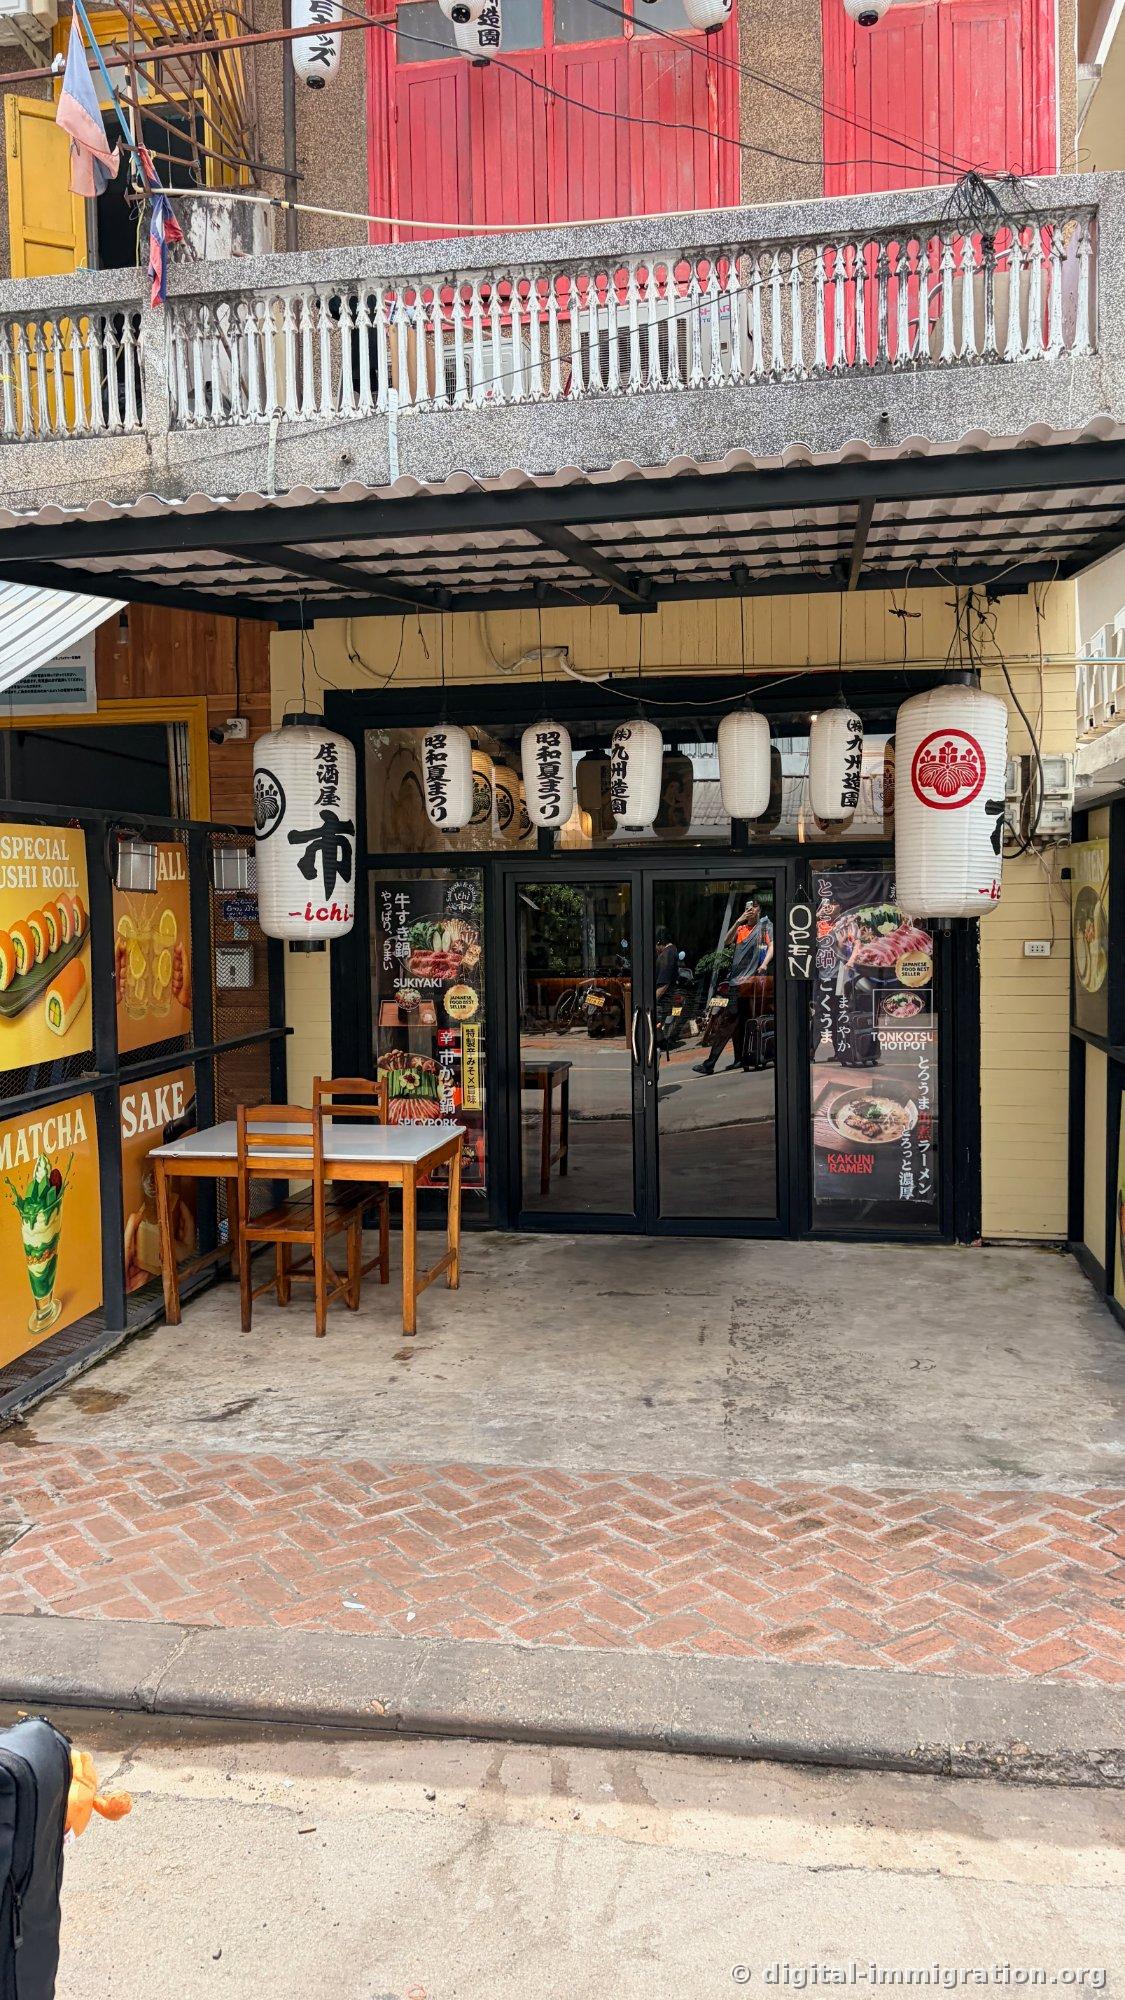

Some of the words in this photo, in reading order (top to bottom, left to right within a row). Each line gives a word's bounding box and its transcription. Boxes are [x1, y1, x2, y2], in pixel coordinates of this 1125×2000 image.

[313, 742, 341, 807] 居酒屋
[424, 733, 451, 823] 昭和夏まつり
[535, 730, 564, 820] 昭和夏まつり
[0, 835, 70, 861] SPECIAL
[41, 865, 80, 889] ROLL
[287, 809, 355, 902] 市
[394, 892, 412, 958] 牛すき鍋
[787, 905, 813, 978] OPEN
[393, 977, 443, 989] SUKIYAKI
[837, 996, 851, 1053] まろやか
[871, 1031, 934, 1043] TONKOTSU
[879, 1041, 928, 1051] HOTPOT
[121, 1080, 186, 1139] SAKE
[0, 1108, 88, 1172] MATCHA
[827, 1154, 875, 1164] KAKUNI
[828, 1163, 873, 1174] RAMEN
